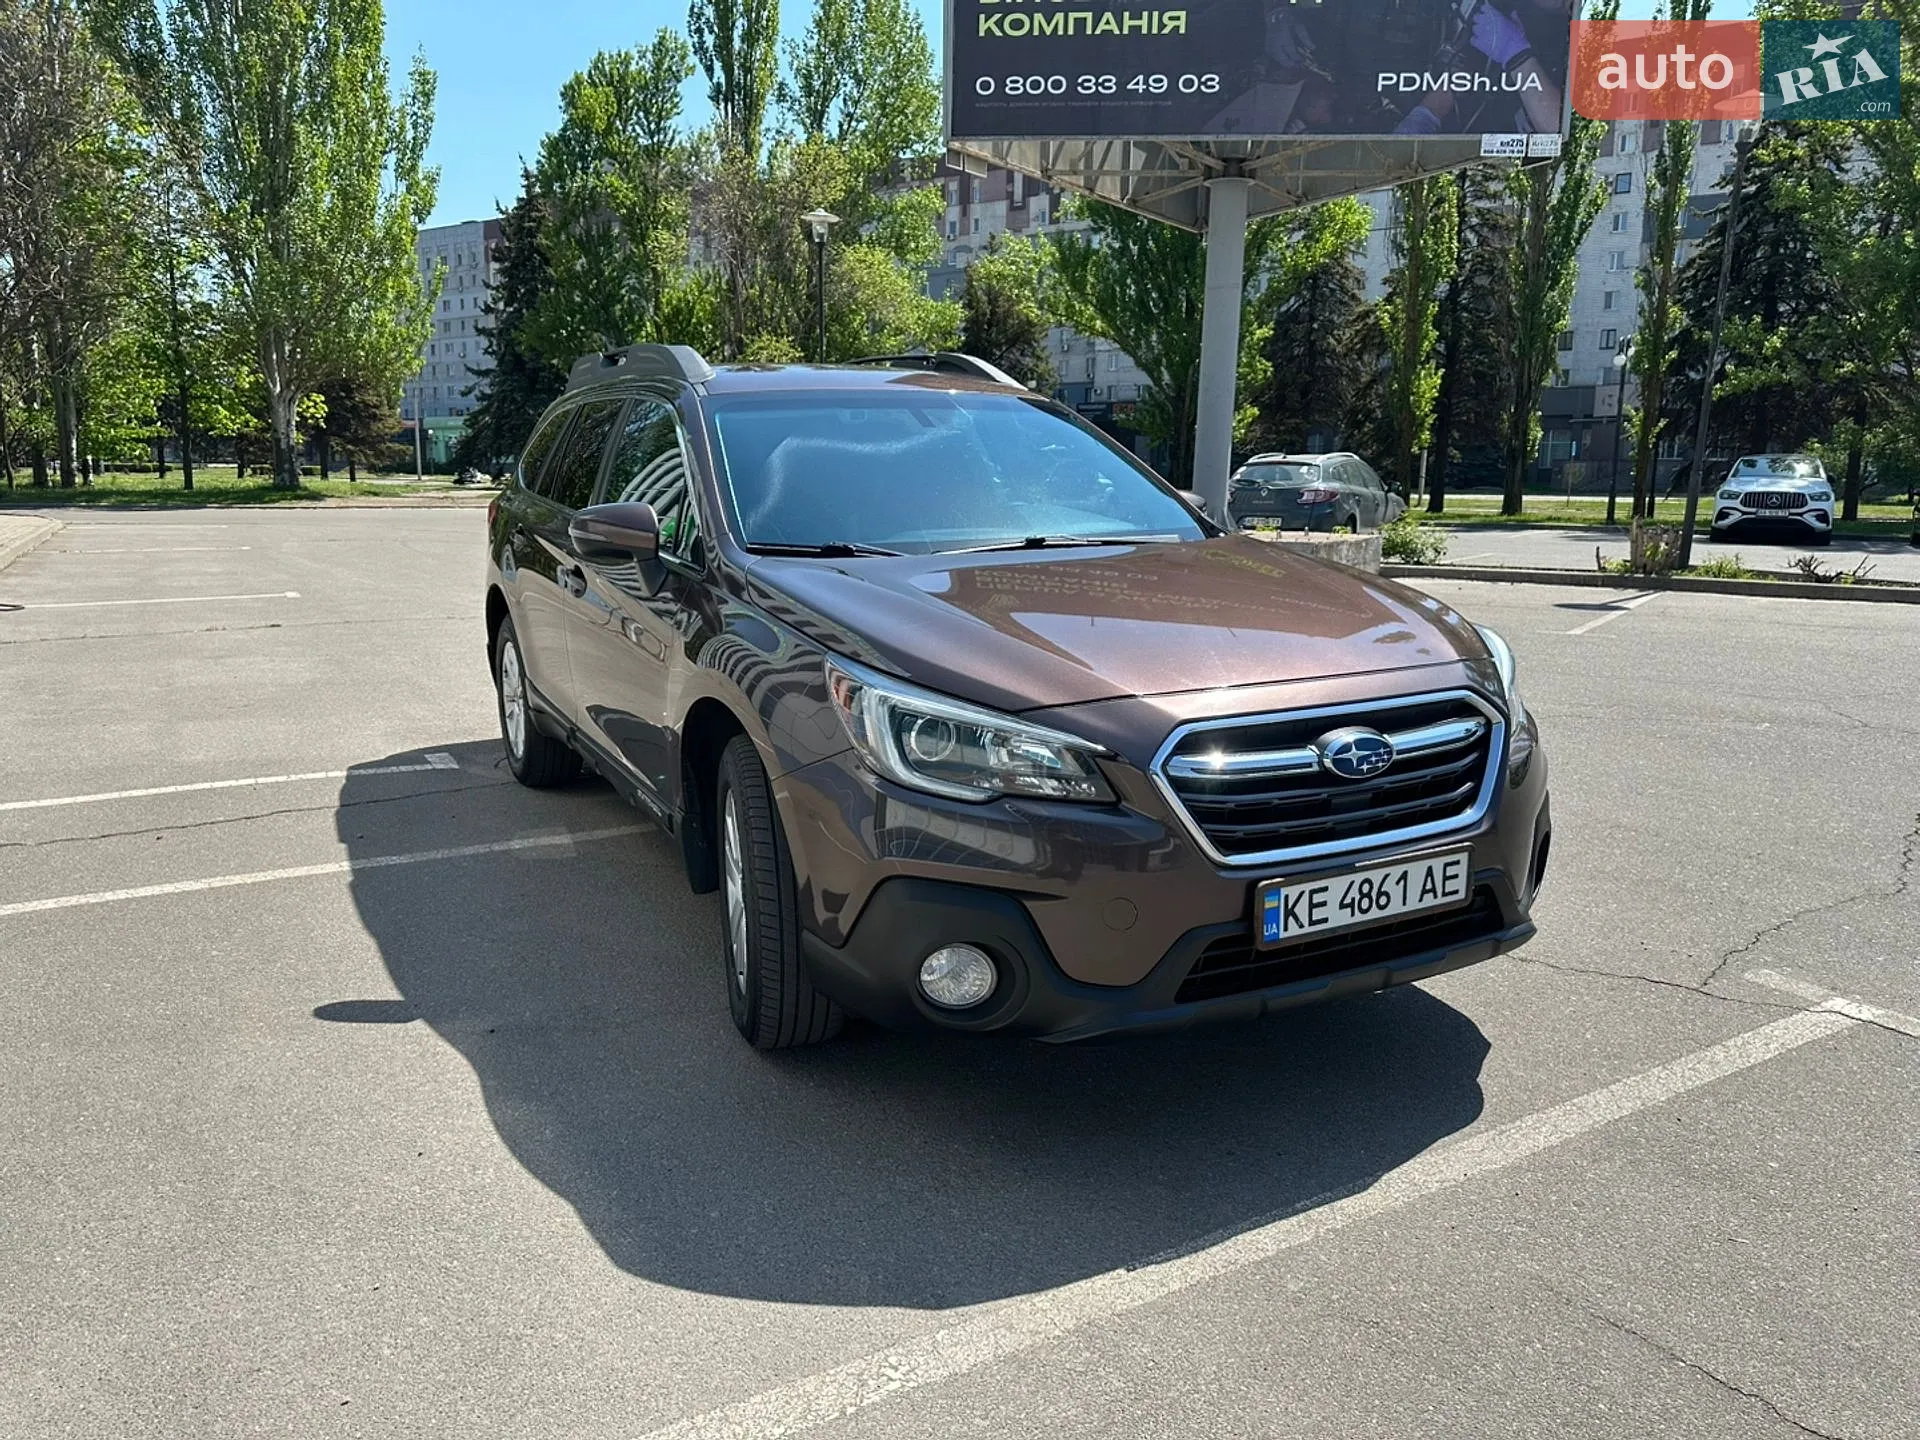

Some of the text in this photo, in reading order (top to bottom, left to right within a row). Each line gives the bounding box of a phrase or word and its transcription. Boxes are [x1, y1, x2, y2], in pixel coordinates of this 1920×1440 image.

[978, 11, 1187, 37] КОМПАНІЯ
[975, 74, 1220, 95] 0 800 33 49 03
[1377, 72, 1543, 92] PDMSh.UA
[1283, 860, 1461, 932] KE 4861 AE
[1263, 921, 1279, 936] UA
